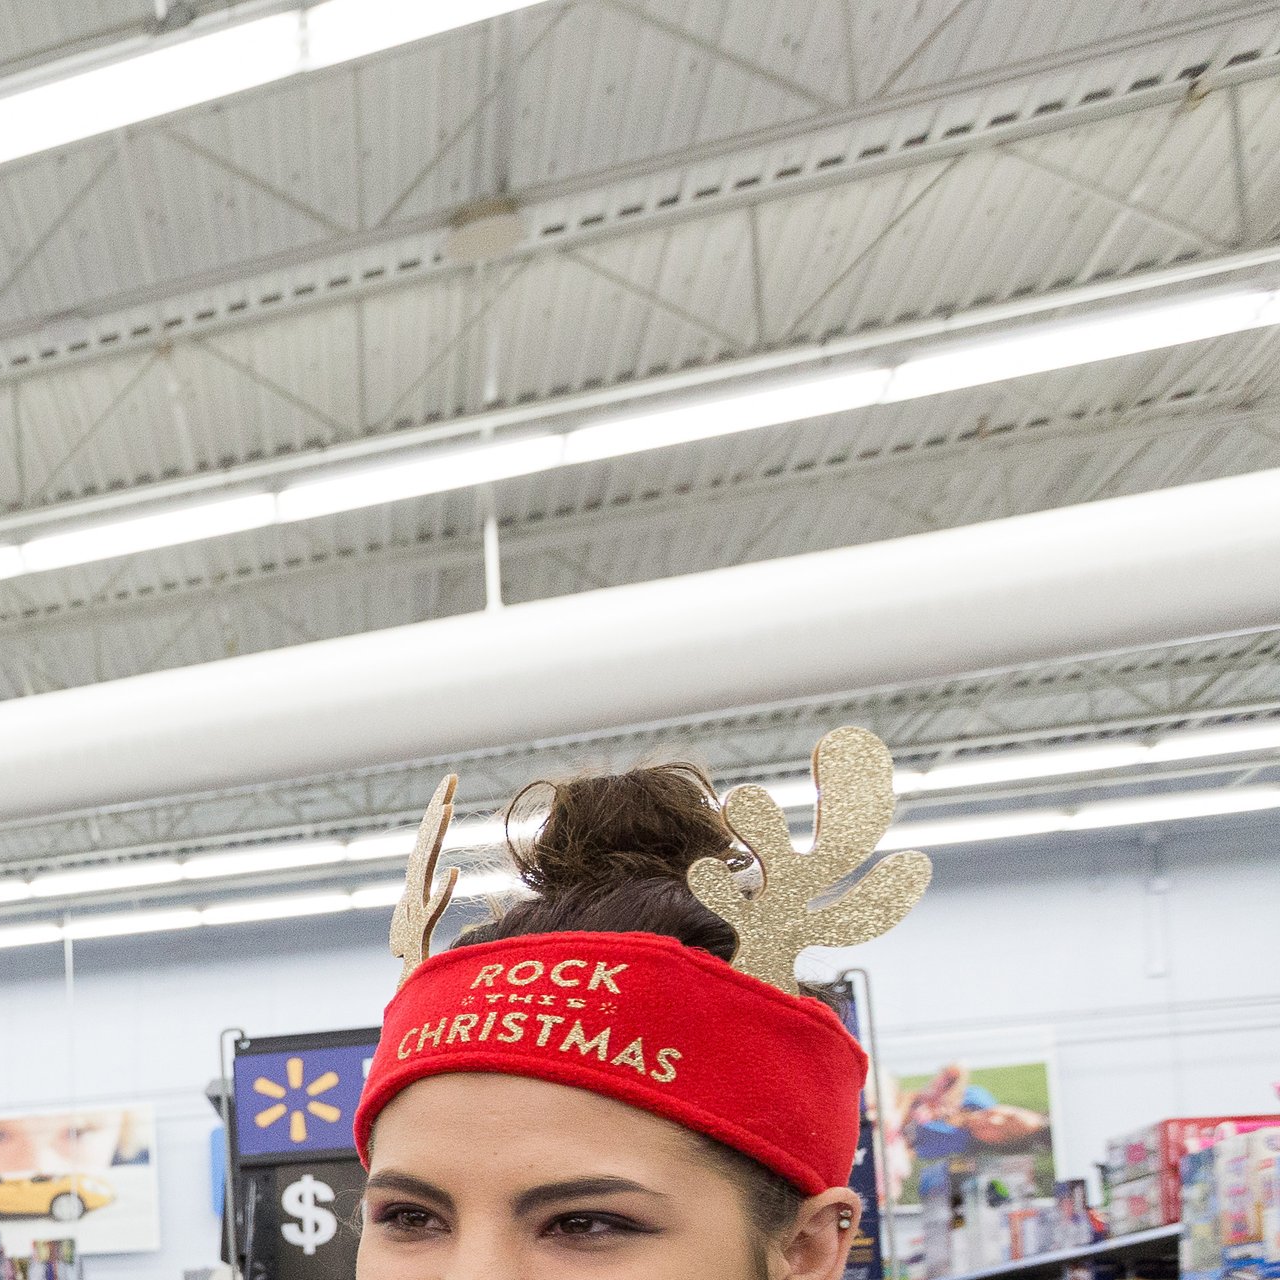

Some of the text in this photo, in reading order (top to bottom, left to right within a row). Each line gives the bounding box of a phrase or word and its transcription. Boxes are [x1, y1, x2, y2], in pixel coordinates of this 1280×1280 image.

[470, 960, 629, 994] ROCK
[485, 993, 587, 1009] THIS
[397, 1011, 683, 1083] CHRISTMAS
[281, 1174, 338, 1255] $
